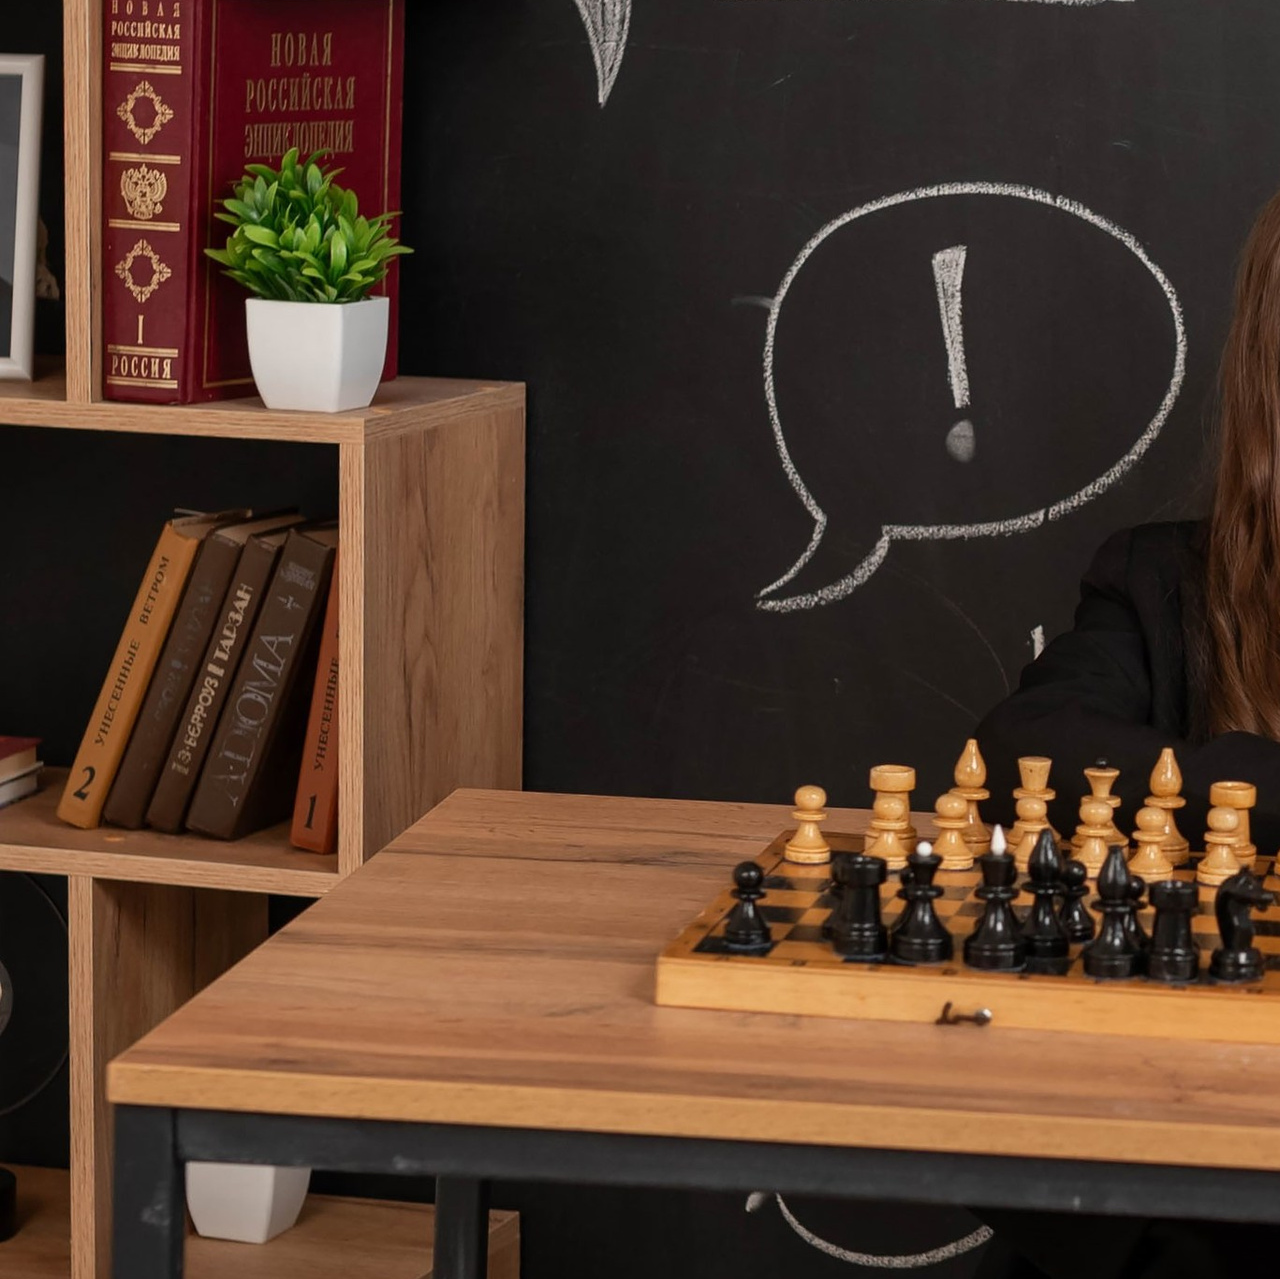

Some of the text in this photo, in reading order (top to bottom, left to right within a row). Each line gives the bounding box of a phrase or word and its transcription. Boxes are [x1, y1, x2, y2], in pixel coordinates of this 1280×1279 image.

[111, 20, 181, 40] РОССИЙСКАЯ
[111, 42, 181, 62] ЭНЦИКЛОПЕДИЯ
[270, 31, 333, 68] НОВАЯ
[245, 72, 356, 114] РОССИЙСКАЯ
[244, 120, 355, 163] ЭНЦИКЛОПЕДИЯ
[111, 354, 173, 380] РОССИЯ
[213, 582, 254, 662] ТАРЗАН
[94, 555, 170, 747] УНЕСЕННЫЕ ВЕТРОМ
[314, 656, 339, 773] УНЕСЕННЫЕ
[72, 765, 96, 802] 2
[304, 794, 317, 829] 1
